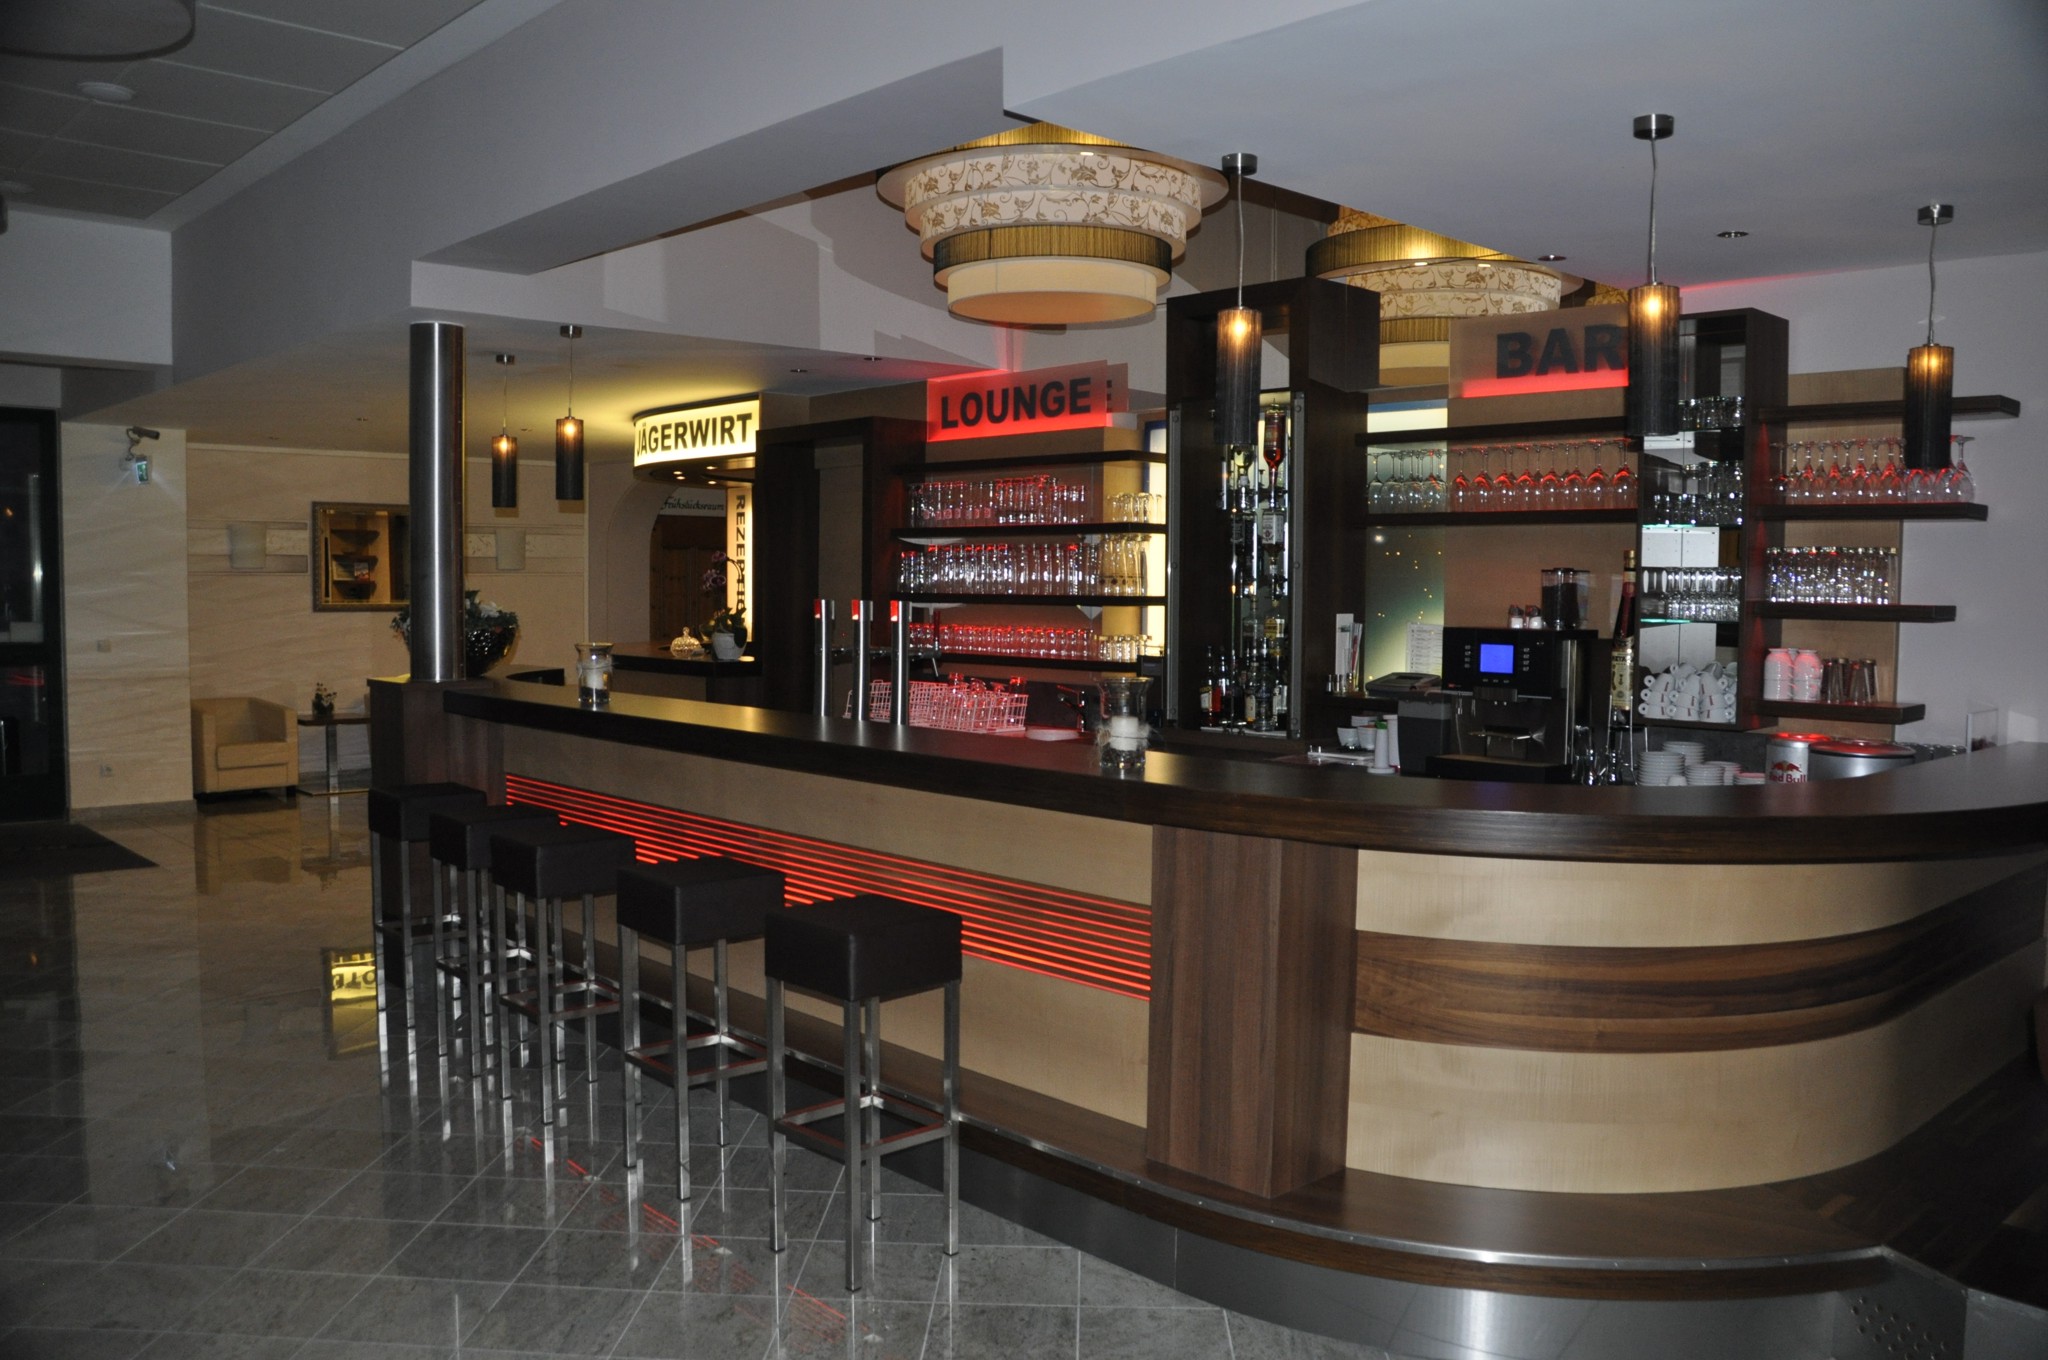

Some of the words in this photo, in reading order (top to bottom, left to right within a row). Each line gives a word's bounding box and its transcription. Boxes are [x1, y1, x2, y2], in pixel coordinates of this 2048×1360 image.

[1496, 324, 1629, 379] BAR
[941, 377, 1091, 429] LOUNGE
[636, 412, 752, 457] JÄGERWIRT
[736, 494, 746, 626] REZEPTIO
[1786, 773, 1806, 783] Bull
